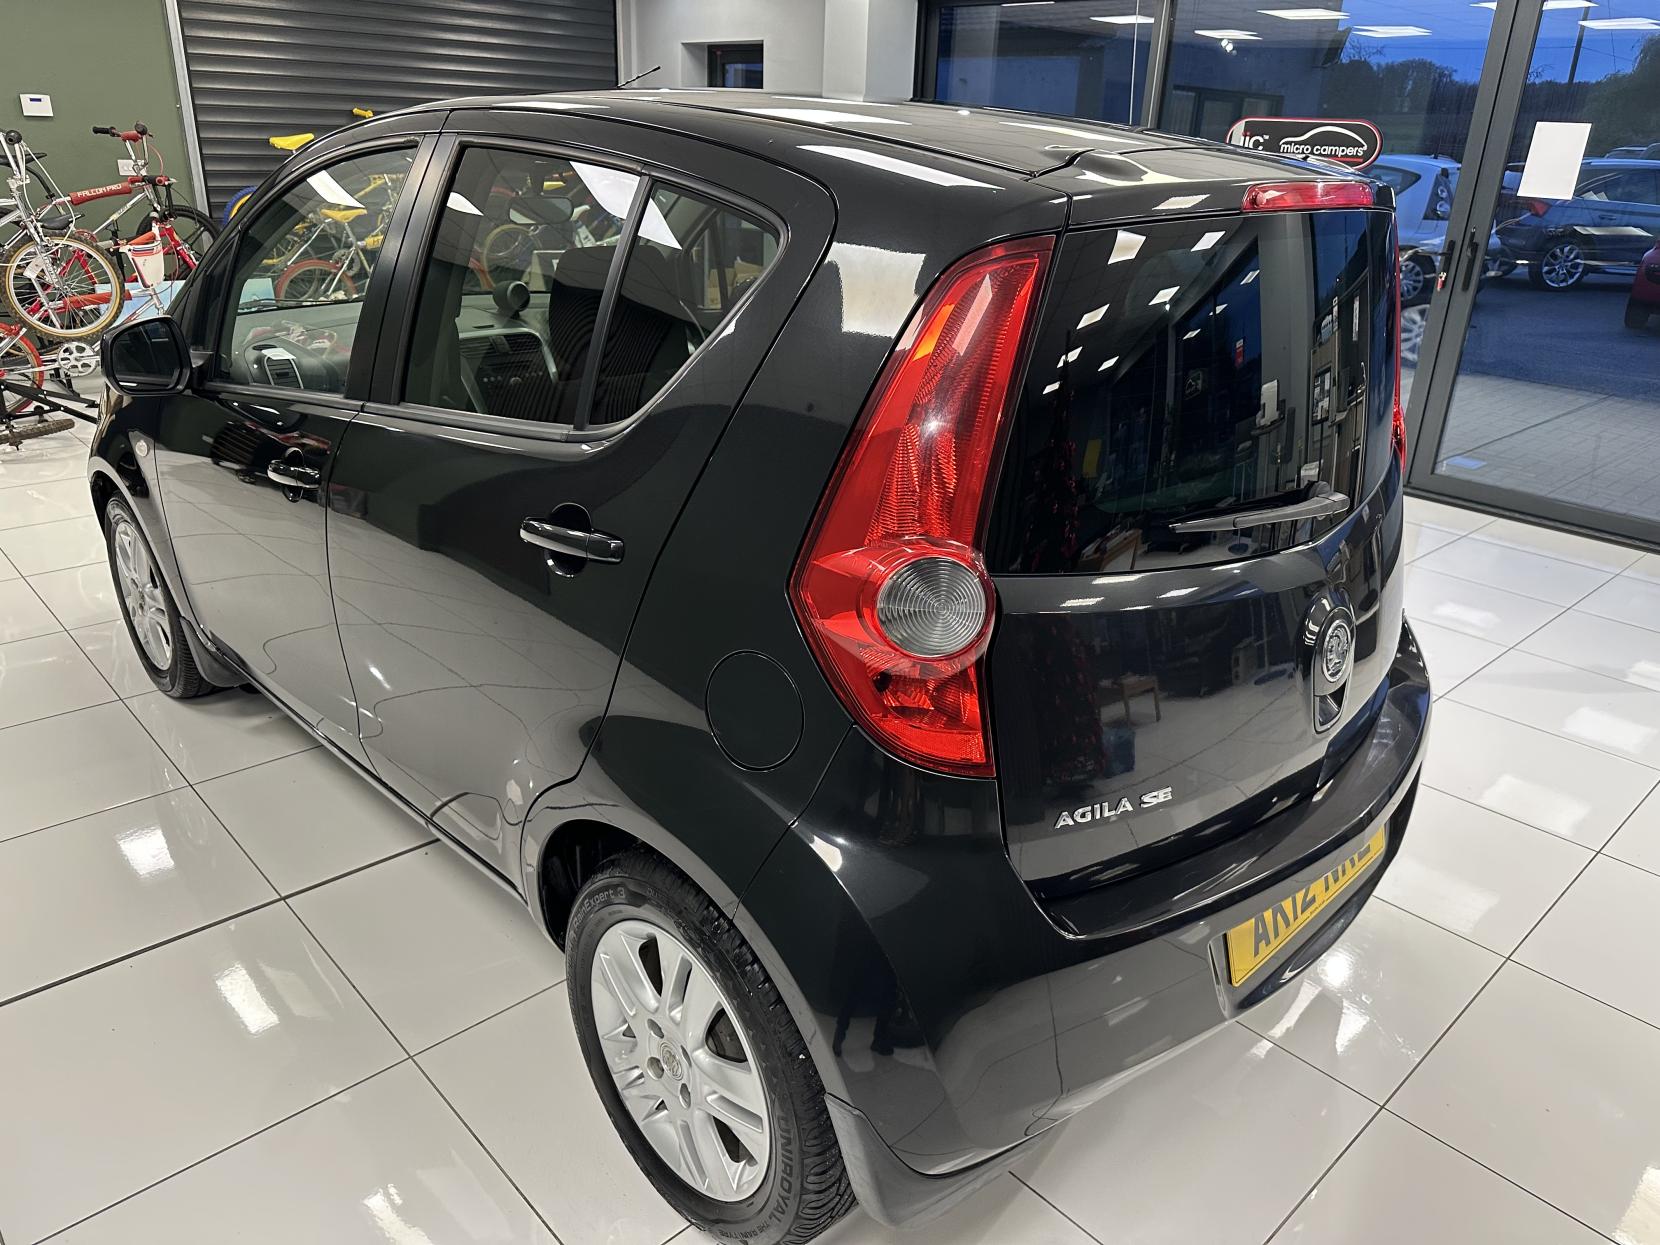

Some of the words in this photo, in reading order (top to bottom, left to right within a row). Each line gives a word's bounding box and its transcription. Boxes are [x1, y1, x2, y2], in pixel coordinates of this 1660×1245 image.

[1280, 143, 1310, 154] micro
[1313, 144, 1364, 157] campers
[106, 184, 122, 192] PRO
[1055, 797, 1134, 829] AGILA
[1140, 786, 1173, 808] SE
[617, 887, 626, 899] 3
[769, 1115, 793, 1223] UNIROYAL
